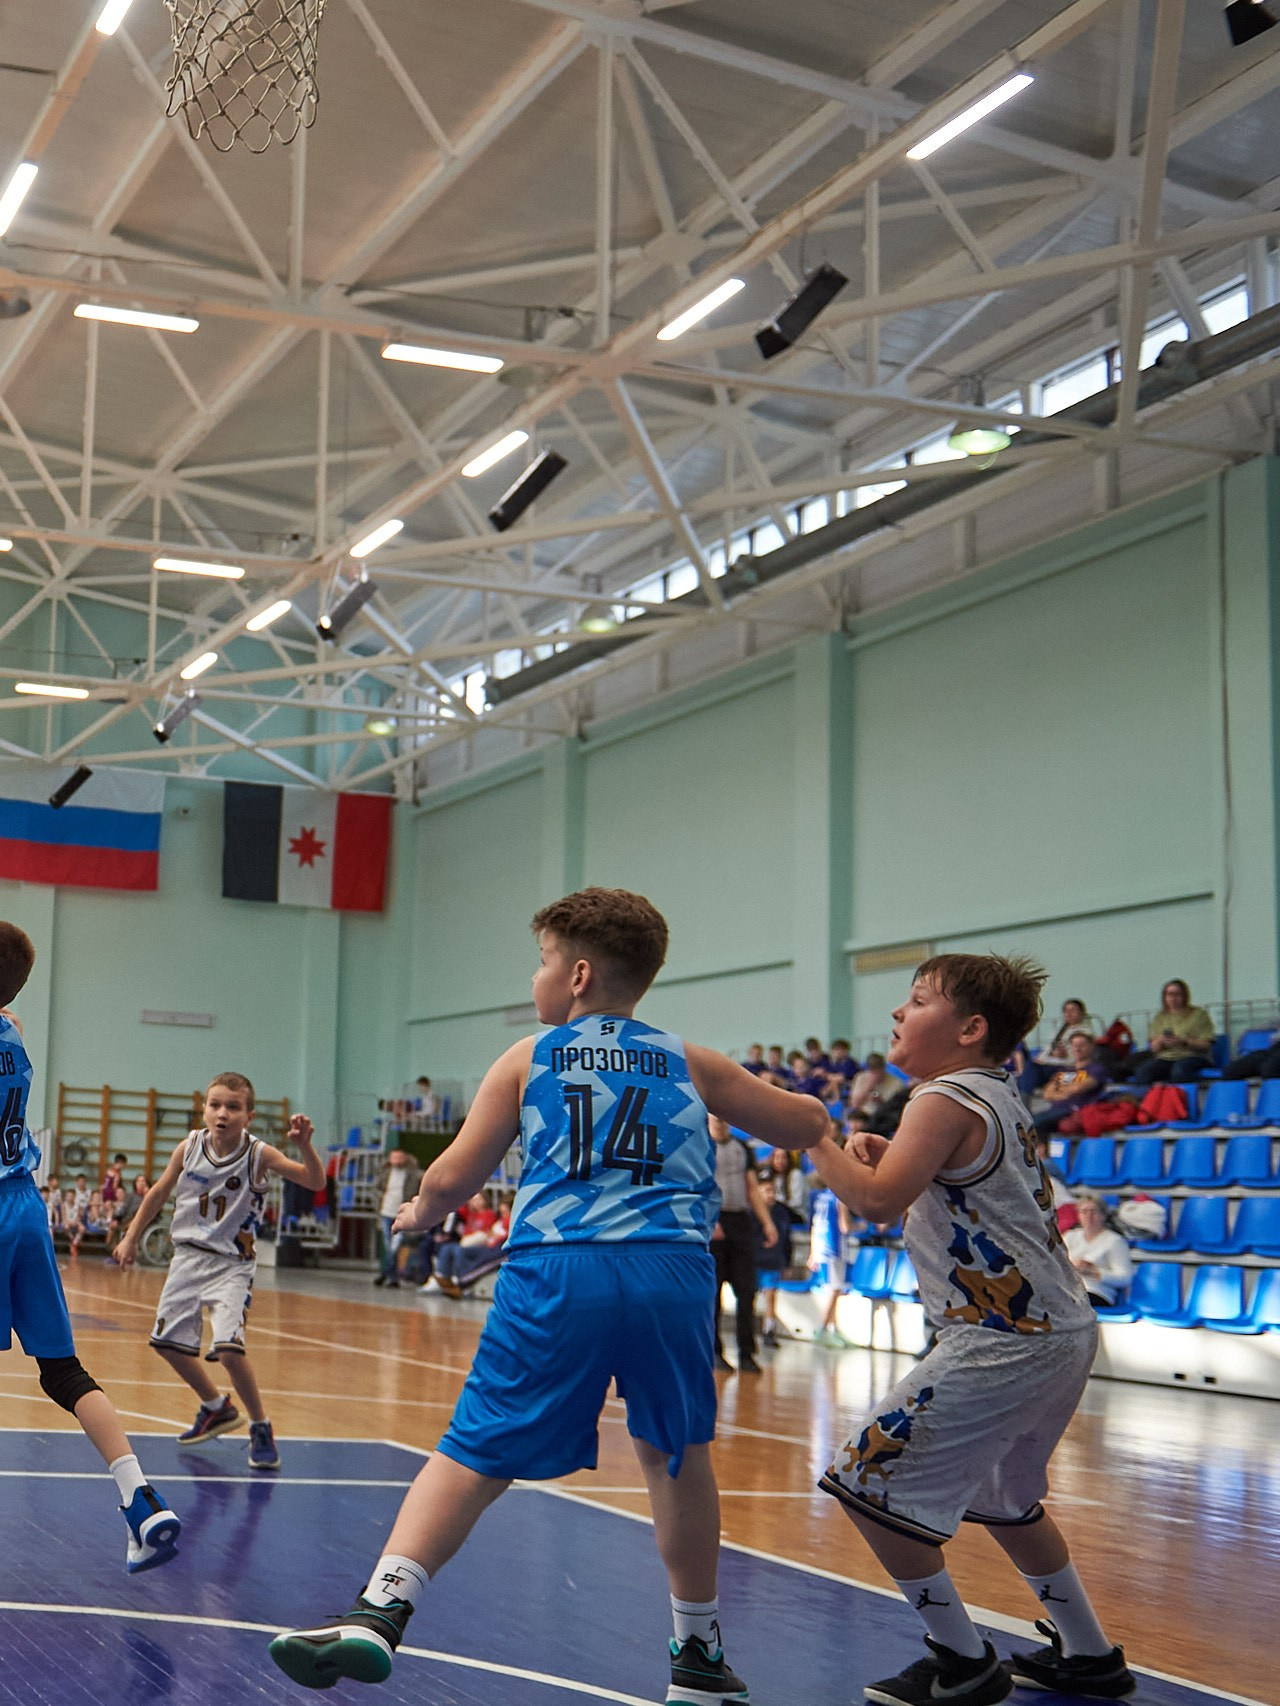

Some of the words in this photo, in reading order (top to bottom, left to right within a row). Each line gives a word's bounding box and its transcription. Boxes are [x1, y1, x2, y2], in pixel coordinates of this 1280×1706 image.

[551, 1047, 669, 1079] ПРОЗОРОВ
[563, 1084, 665, 1186] 14
[199, 1192, 227, 1222] 11
